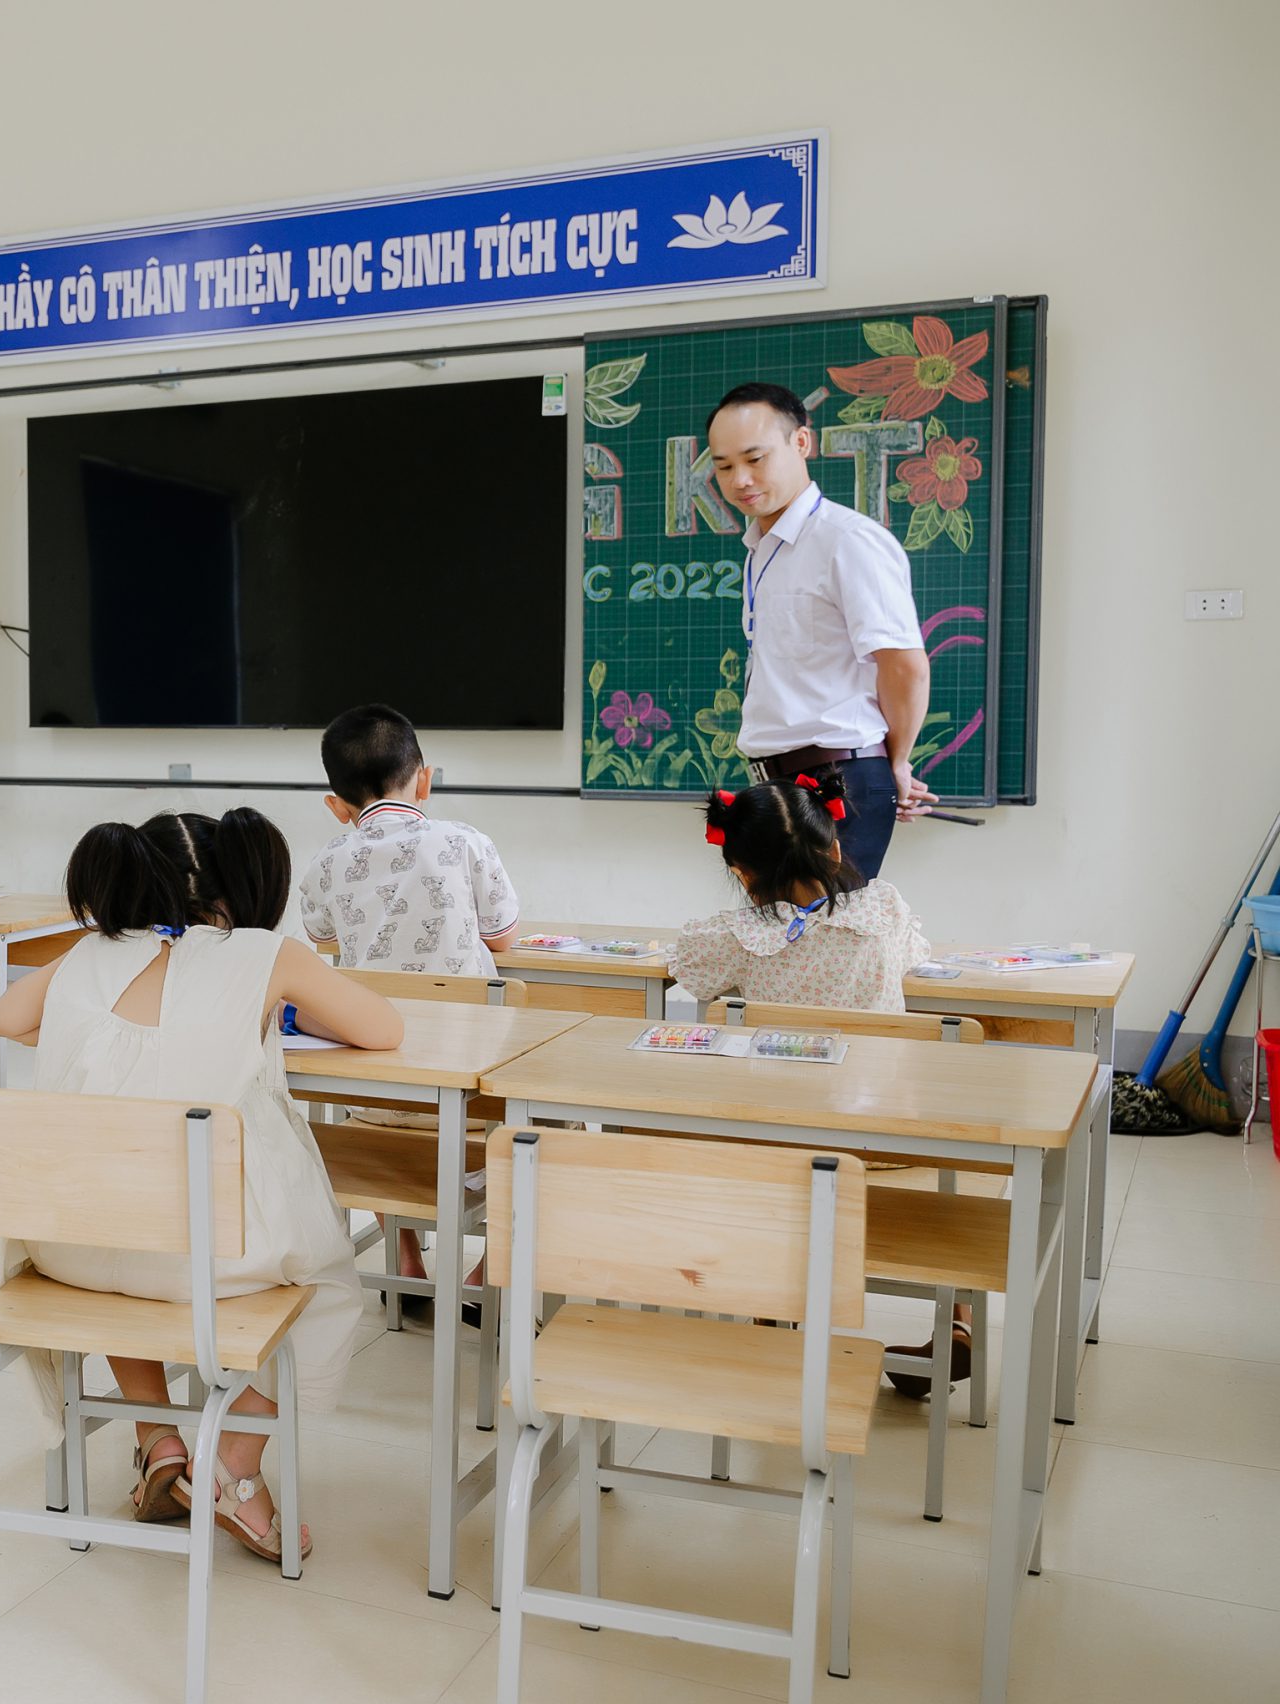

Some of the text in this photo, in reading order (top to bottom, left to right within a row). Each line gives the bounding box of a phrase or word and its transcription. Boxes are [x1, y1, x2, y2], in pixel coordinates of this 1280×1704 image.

[59, 264, 96, 325] CÔ
[103, 256, 188, 320] THÂN
[194, 243, 300, 315] THIỆN,
[308, 241, 373, 305] HỌC
[381, 229, 467, 291] SINH
[474, 212, 557, 280] TÍCH
[566, 208, 638, 278] CỰC
[628, 560, 743, 602] 2022
